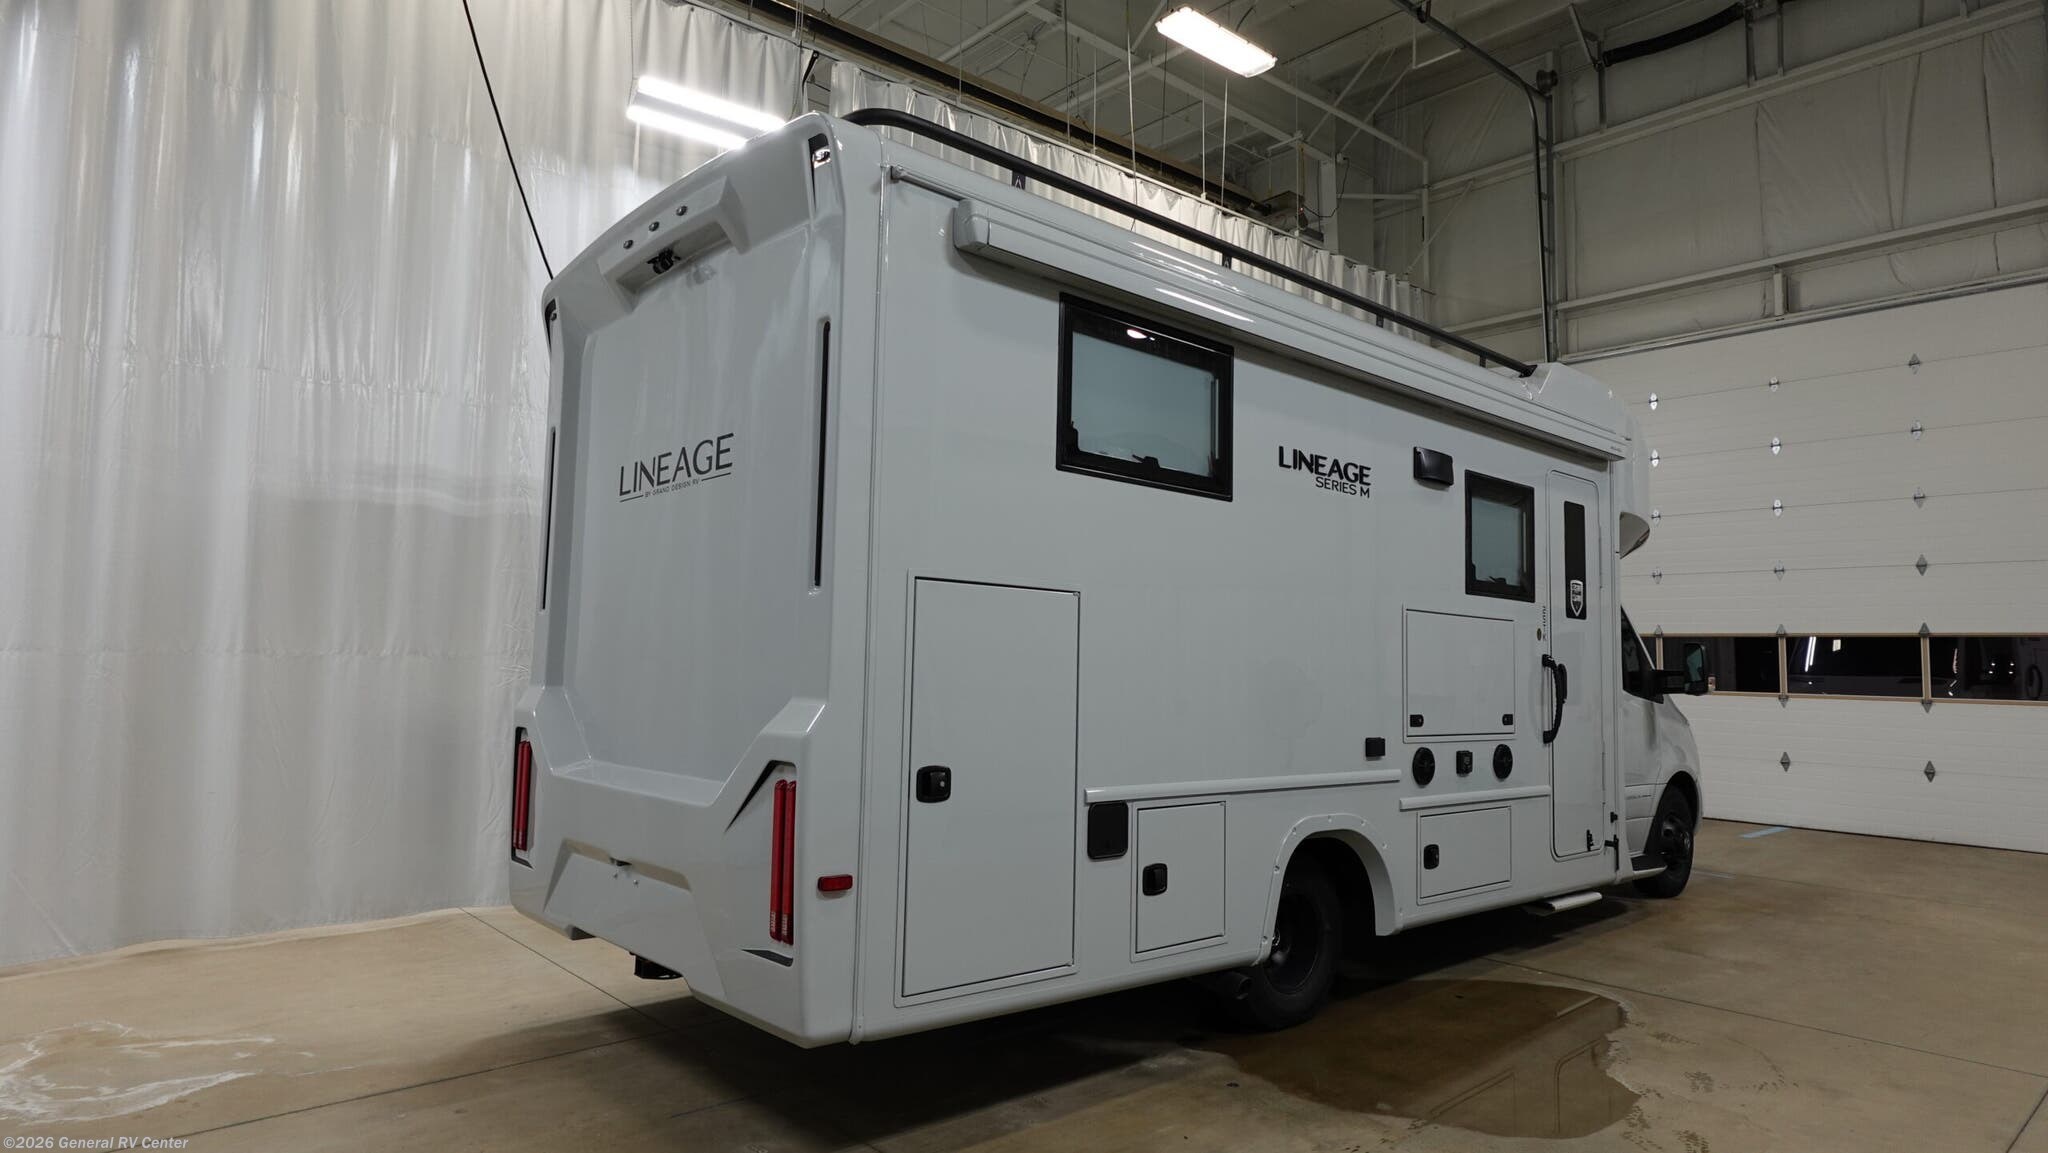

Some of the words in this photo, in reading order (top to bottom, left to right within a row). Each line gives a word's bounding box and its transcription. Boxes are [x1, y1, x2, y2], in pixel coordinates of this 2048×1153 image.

[619, 432, 734, 496] LINEAGE
[1279, 445, 1371, 486] LINEAGE
[1315, 476, 1357, 496] SERIES
[1360, 486, 1370, 499] M
